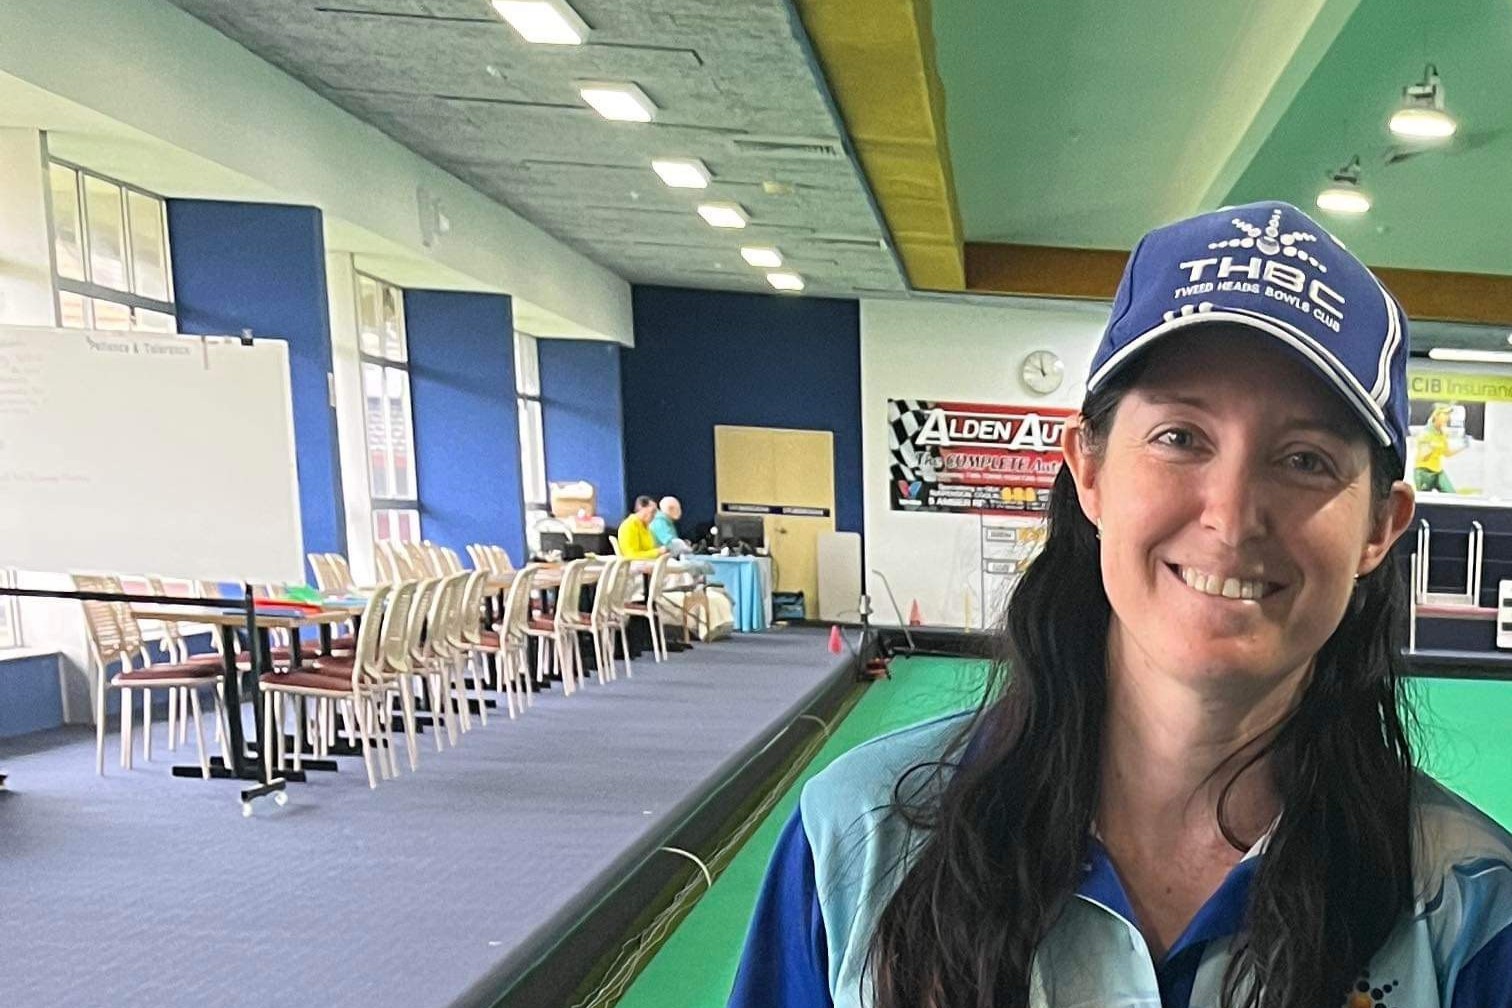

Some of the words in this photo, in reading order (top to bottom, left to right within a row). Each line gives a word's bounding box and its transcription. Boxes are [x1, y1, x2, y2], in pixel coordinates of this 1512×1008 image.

[1174, 282, 1213, 299] TWEED
[1217, 281, 1260, 294] HEADS
[1264, 286, 1310, 313] BOWLS
[1313, 307, 1341, 333] CLUB
[1179, 256, 1346, 320] THBC
[1411, 377, 1442, 393] CIB
[915, 408, 1012, 446] ALDEN
